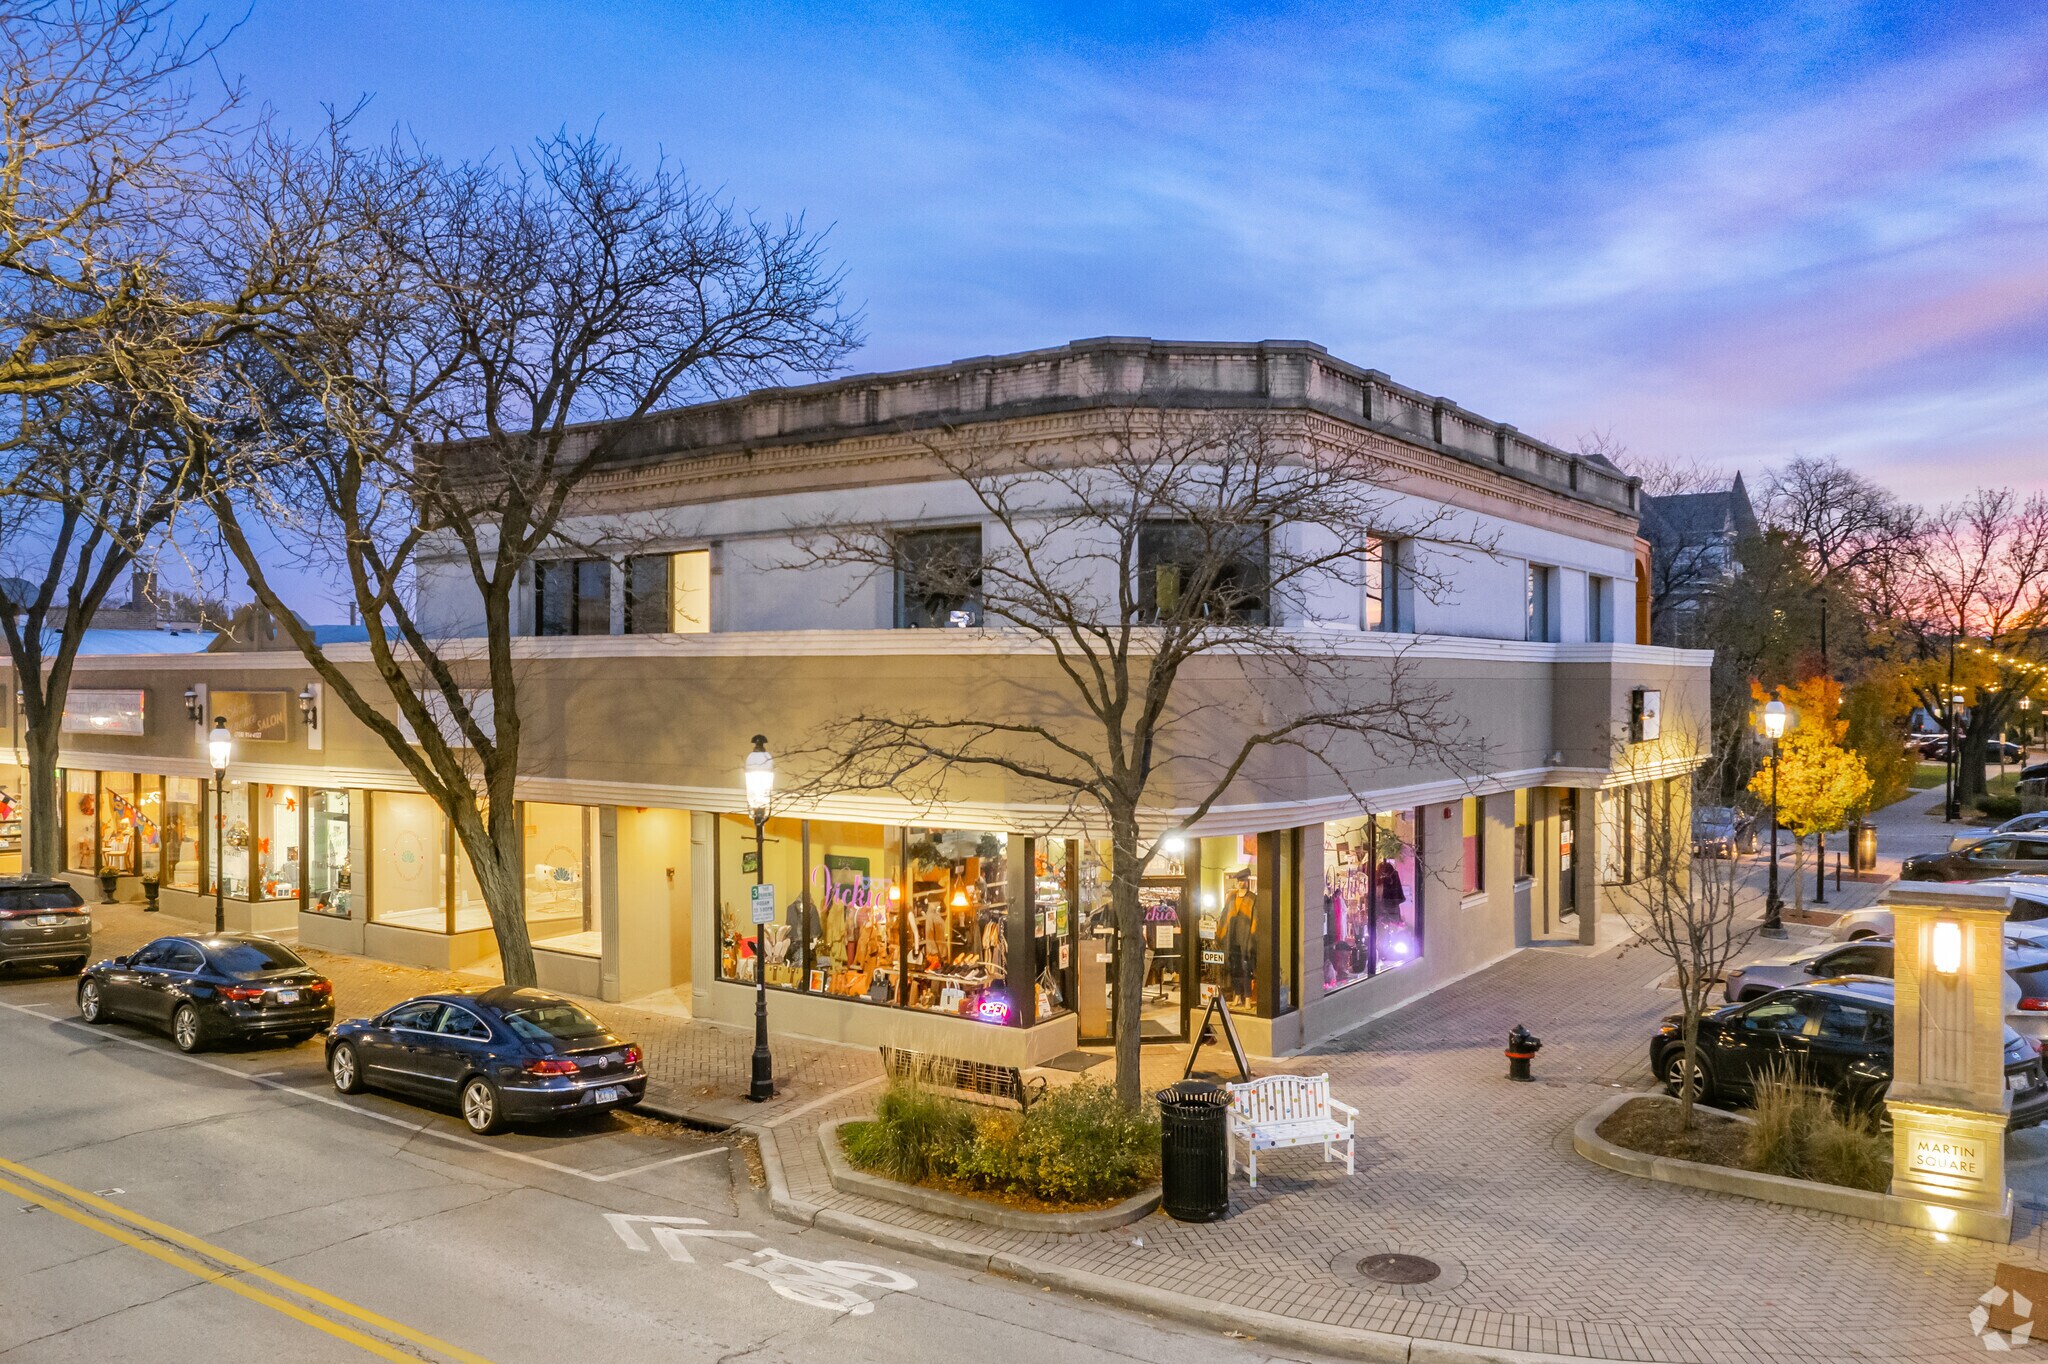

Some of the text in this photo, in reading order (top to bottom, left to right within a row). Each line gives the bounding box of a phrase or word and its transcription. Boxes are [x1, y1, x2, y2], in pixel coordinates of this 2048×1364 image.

[257, 712, 283, 731] SALON
[752, 888, 758, 899] 3
[1204, 953, 1223, 962] OPEN
[981, 1002, 1008, 1017] OPEN
[1918, 1141, 1975, 1158] MARTIN
[1917, 1154, 1976, 1173] SQUARE
